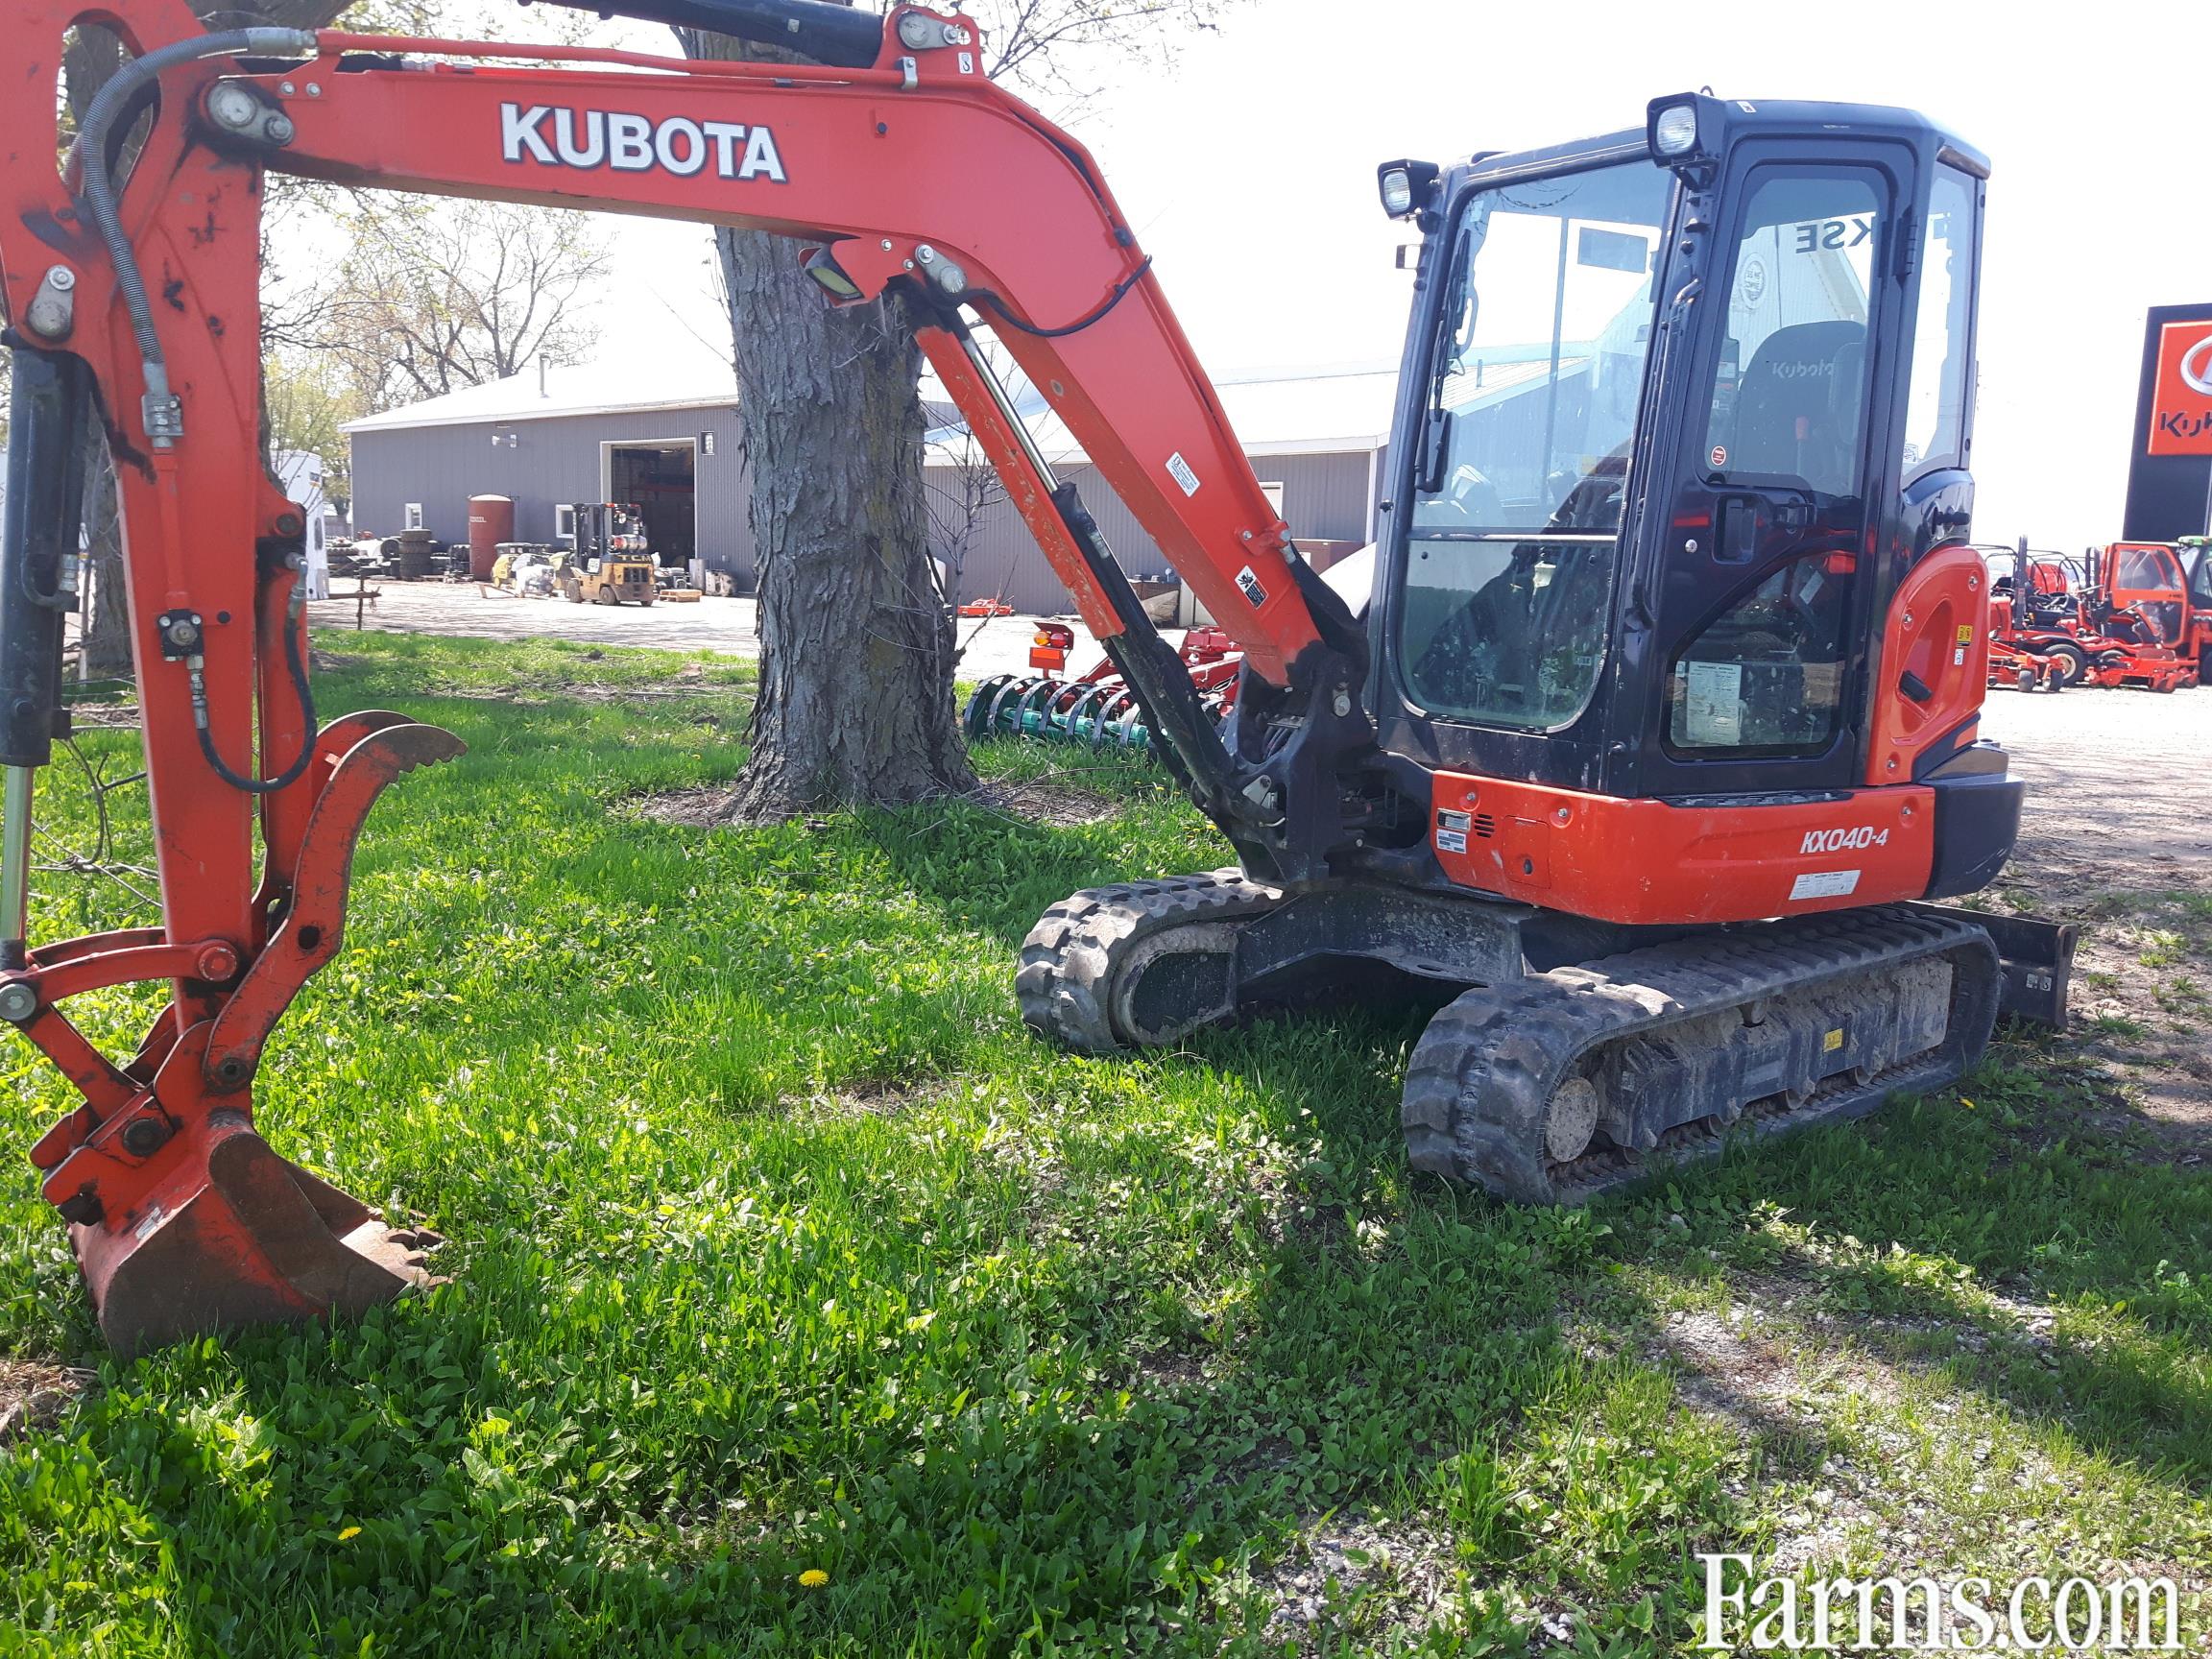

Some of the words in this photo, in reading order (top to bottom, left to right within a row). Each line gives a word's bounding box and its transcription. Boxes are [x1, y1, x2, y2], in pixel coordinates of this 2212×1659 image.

[500, 103, 787, 182] KUBOTA
[1771, 357, 1837, 378] Kubota
[616, 554, 652, 563] TCM
[1799, 826, 1889, 854] KX040-4
